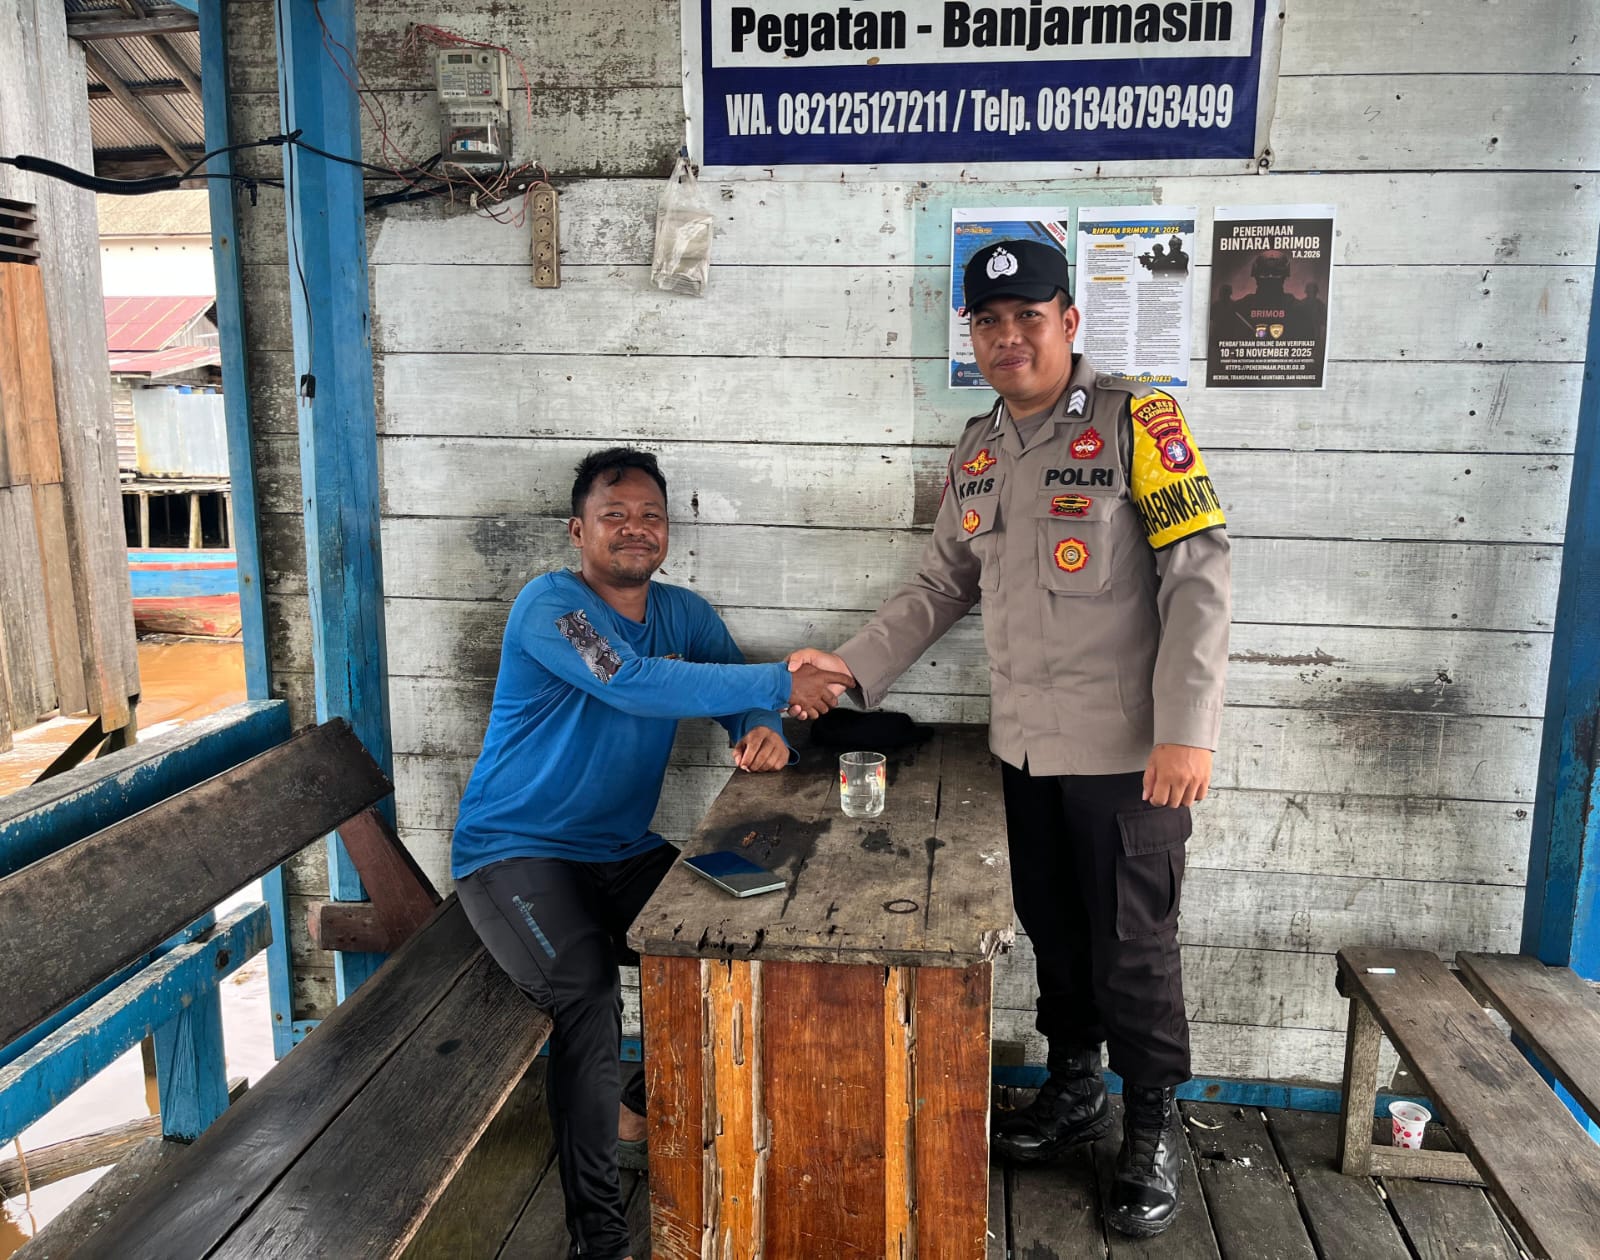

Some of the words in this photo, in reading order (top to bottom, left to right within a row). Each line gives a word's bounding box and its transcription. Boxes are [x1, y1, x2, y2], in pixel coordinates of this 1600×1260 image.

[731, 3, 907, 58] Pegatan
[917, 25, 932, 34] -
[943, 0, 1232, 52] Banjarmasin
[726, 92, 772, 136] WA.
[777, 90, 948, 135] 082125127211
[952, 89, 966, 134] /
[971, 89, 1031, 136] Telp.
[1036, 83, 1234, 132] 081348793499
[1092, 227, 1121, 235] BINTARA
[1233, 225, 1294, 237] PENERIMAAN
[1220, 237, 1270, 251] BINTARA
[1274, 236, 1320, 250] BRIMOB
[1251, 310, 1285, 318] BRIMOB
[1220, 348, 1230, 357] 10
[1246, 348, 1289, 357] NOVEMBER
[1291, 348, 1312, 357] 2025
[1045, 468, 1114, 487] POLRI
[959, 477, 995, 501] KRIS
